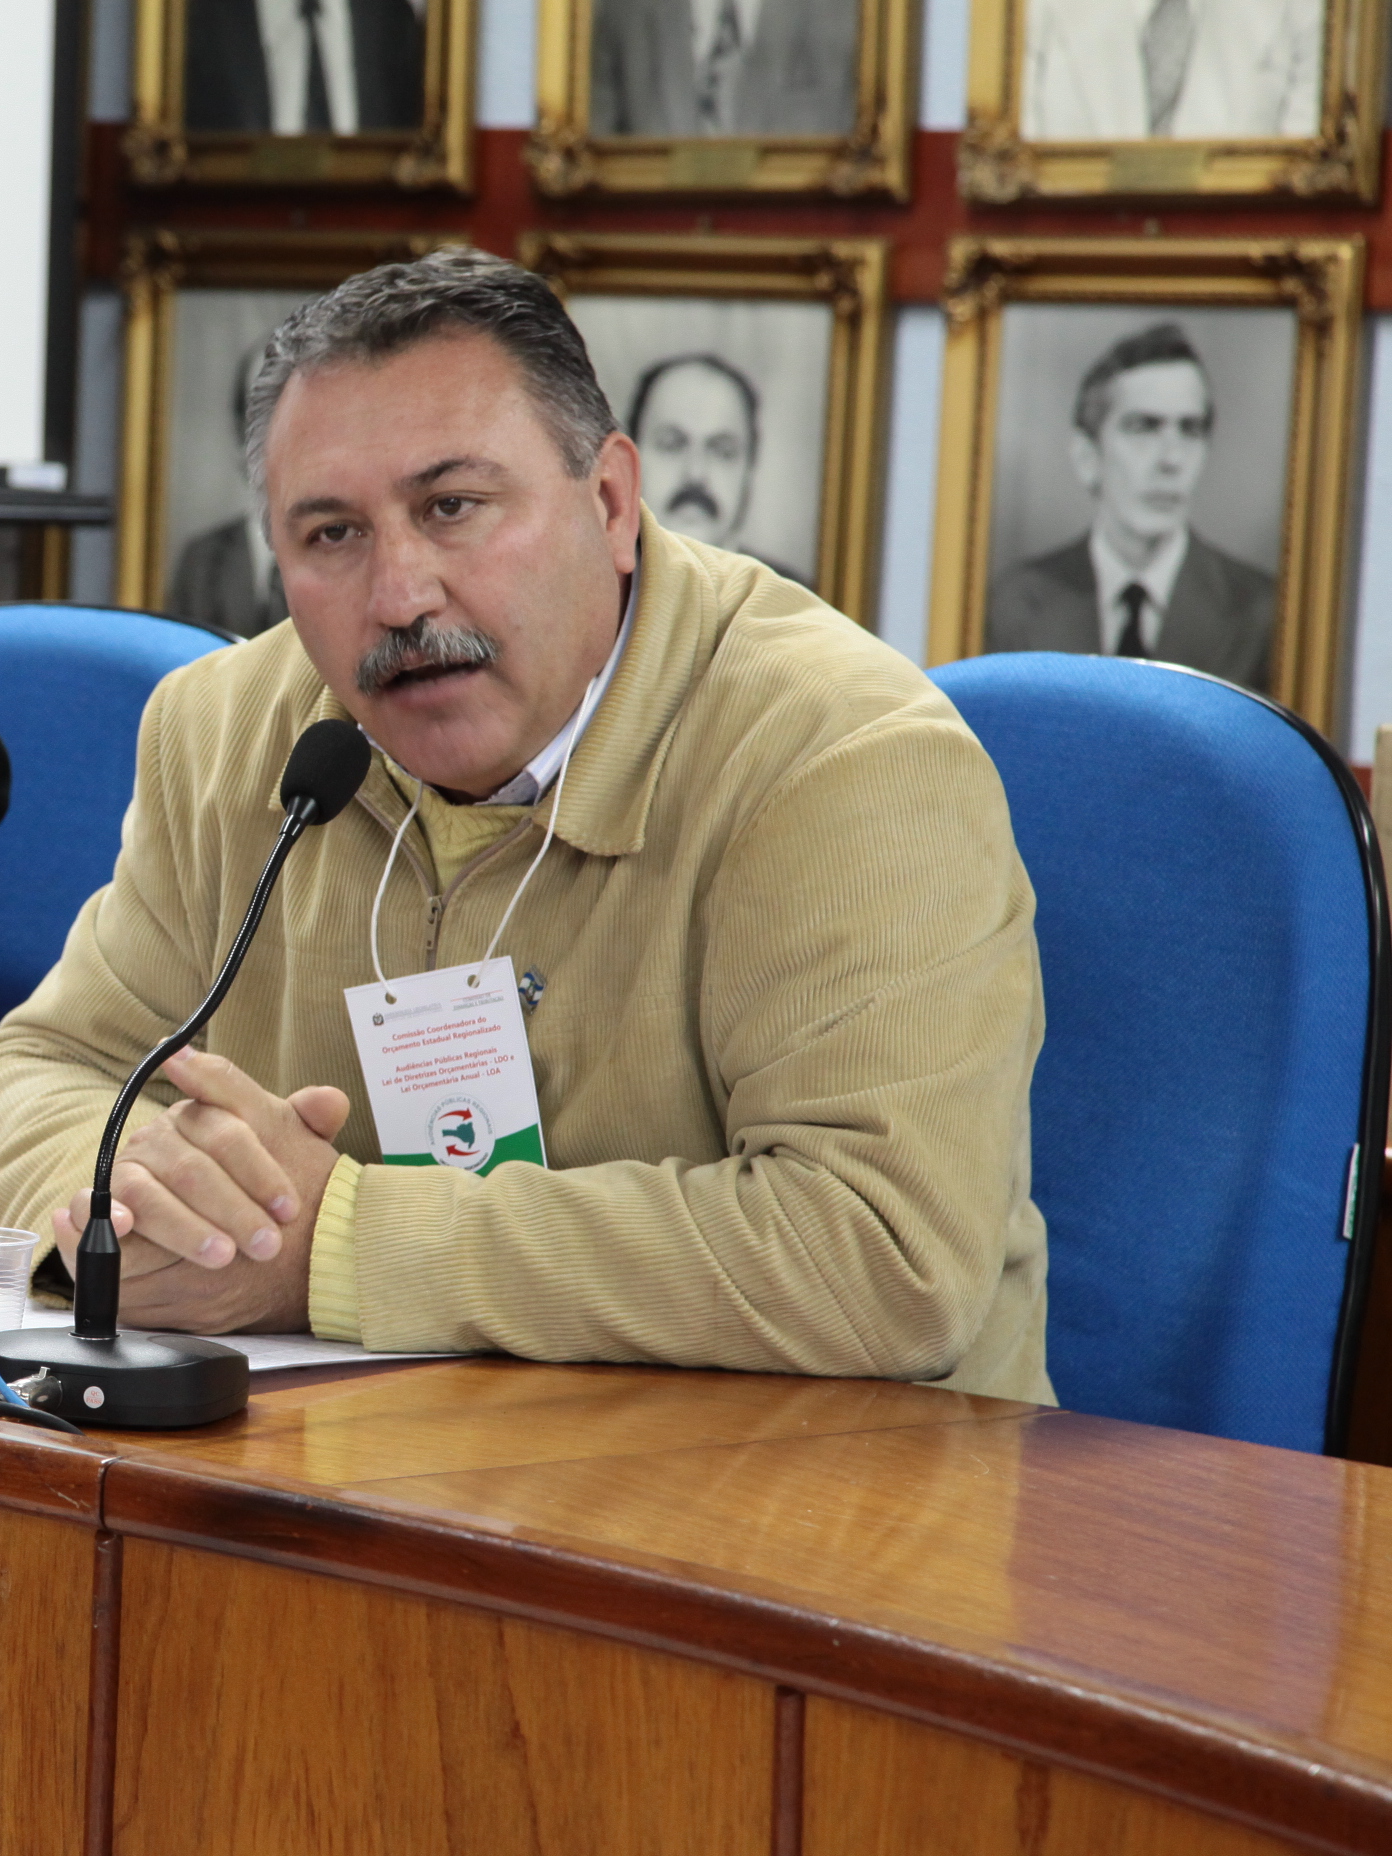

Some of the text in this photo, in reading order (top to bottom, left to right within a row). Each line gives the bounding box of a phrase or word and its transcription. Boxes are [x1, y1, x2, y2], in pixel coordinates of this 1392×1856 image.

[382, 1024, 502, 1054] Orçamento Estadual Regionalizado
[392, 1016, 487, 1041] Comissão Coordenadora do
[382, 1078, 393, 1087] Lei
[394, 1075, 403, 1084] de
[404, 1070, 438, 1083] Diretrizes
[438, 1059, 489, 1076] Orçamentárias
[494, 1054, 509, 1065] LDO
[395, 1046, 498, 1073] Audiências Públicas Regionais
[400, 1084, 411, 1093] Lei
[412, 1077, 459, 1092] Orçamentária
[460, 1071, 481, 1082] Anual
[486, 1067, 501, 1077] LOA
